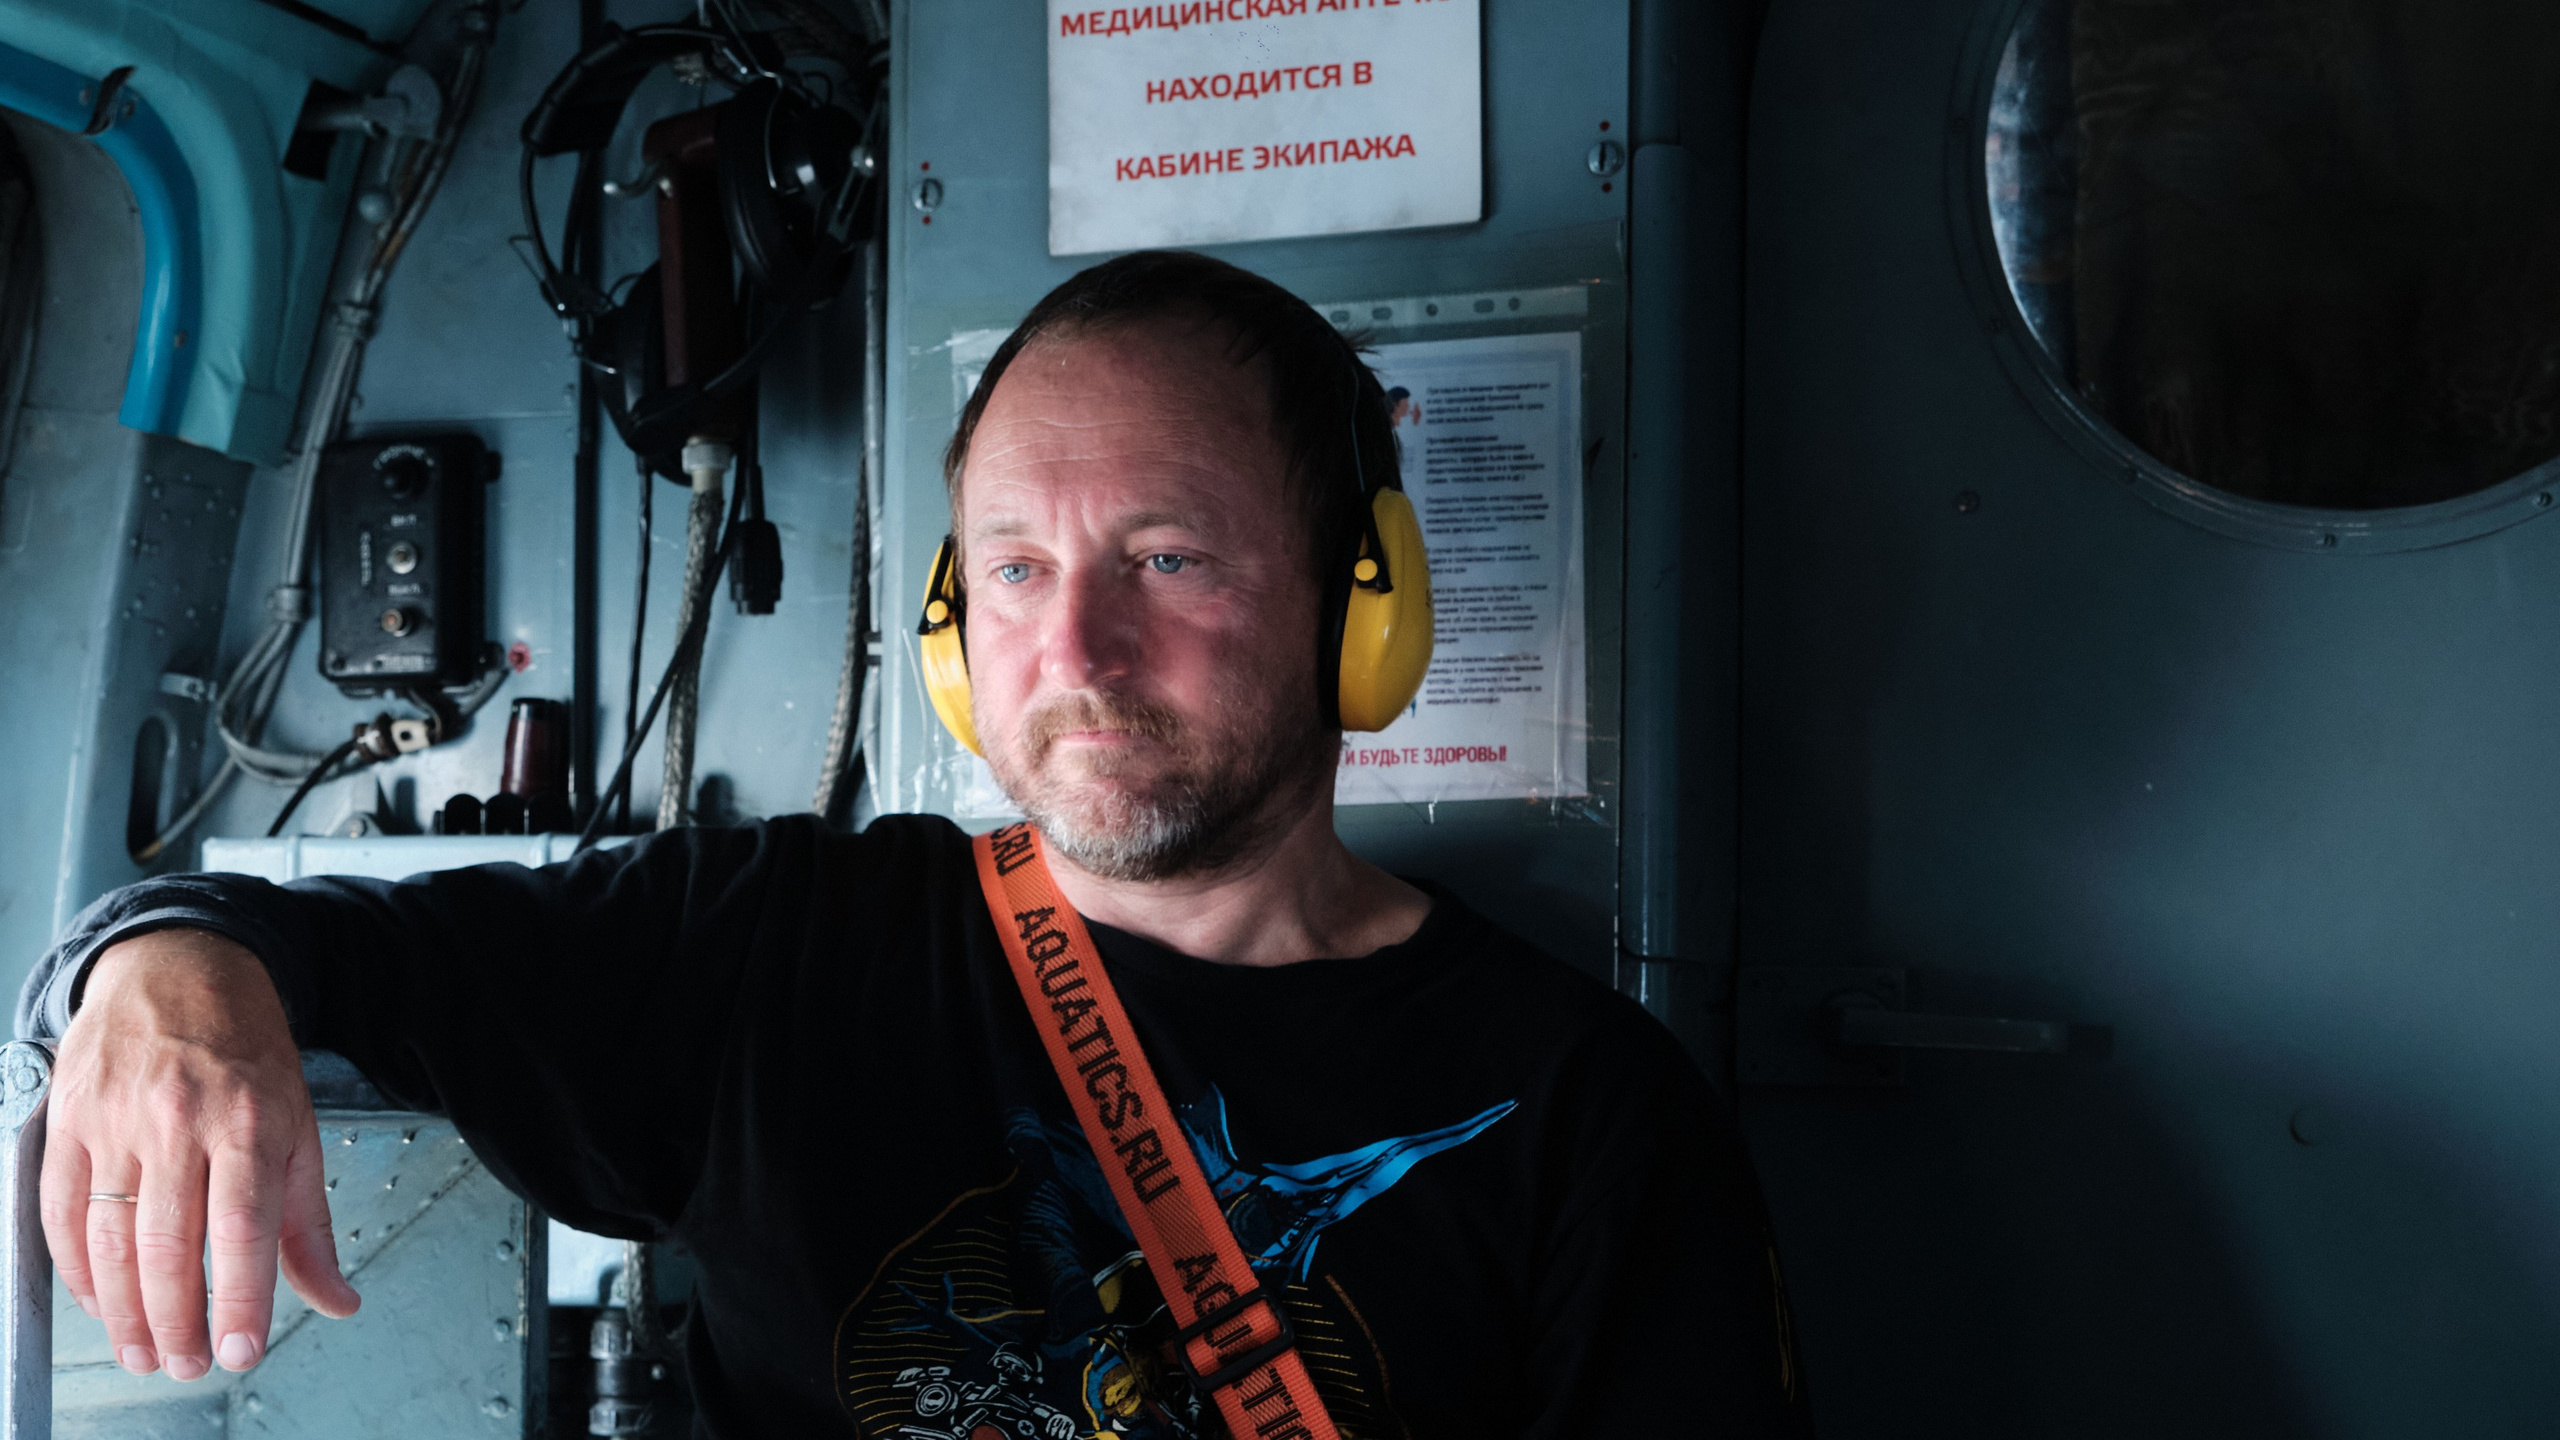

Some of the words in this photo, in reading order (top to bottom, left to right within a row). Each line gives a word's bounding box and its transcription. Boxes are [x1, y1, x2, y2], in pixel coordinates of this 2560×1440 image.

[1060, 0, 1308, 38] МЕДИЦИНСКАЯ
[1146, 63, 1342, 103] НАХОДИТСЯ
[1352, 61, 1373, 85] В
[1116, 148, 1245, 181] КАБИНЕ
[1252, 134, 1417, 170] ЭКИПАЖА
[1359, 748, 1419, 767] БУДЬТЕ
[1014, 906, 1181, 1205] AQUATICS.RU
